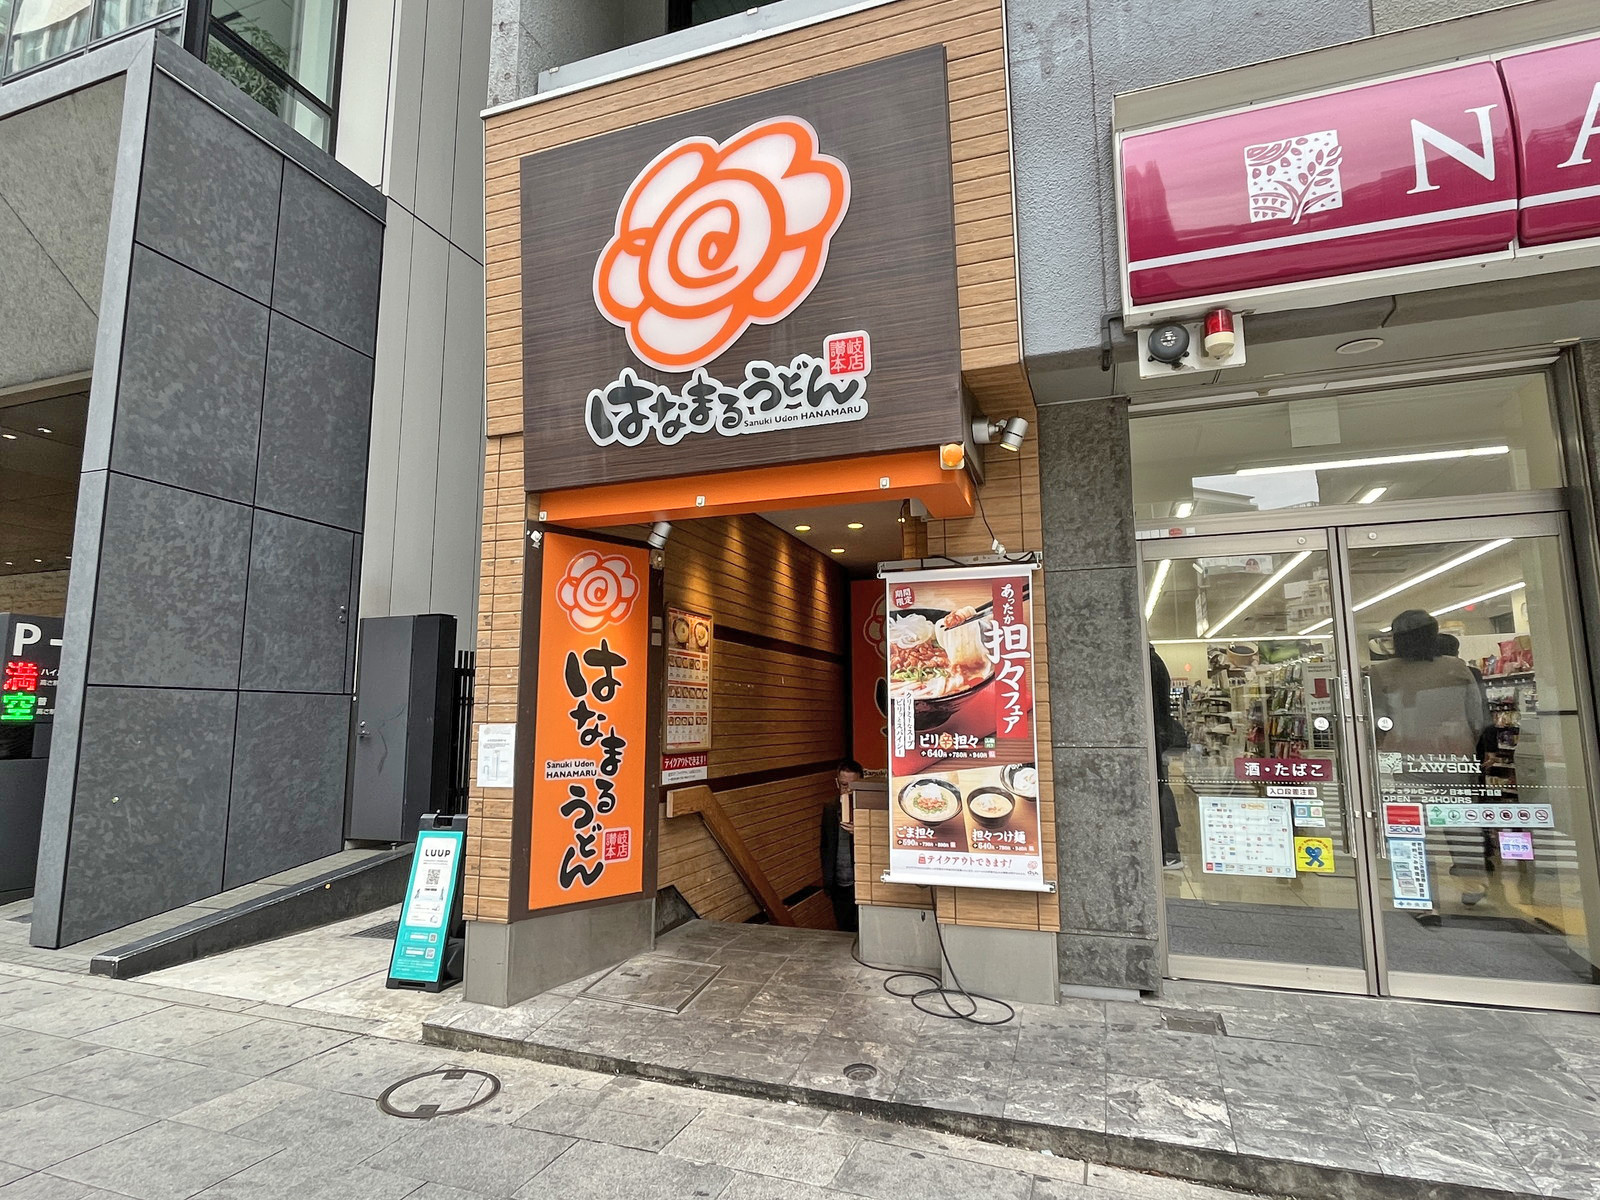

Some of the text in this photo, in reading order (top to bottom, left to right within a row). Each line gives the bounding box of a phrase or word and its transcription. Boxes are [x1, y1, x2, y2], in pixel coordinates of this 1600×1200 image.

[590, 360, 860, 439] はなまるうどん
[744, 405, 862, 428] Sanuki Udon HANAMARU
[12, 622, 42, 656] P
[3, 662, 38, 690] 満
[40, 668, 60, 677] ハイ
[1, 692, 36, 720] 空
[546, 760, 595, 769] Sanuki Udon
[559, 638, 628, 889] はなまるうどん
[1407, 754, 1481, 763] NATURAL
[546, 769, 597, 779] HANAMARU
[1244, 762, 1324, 777] 酒・たばこ
[1408, 762, 1482, 774] LAWSON
[1421, 796, 1472, 804] 24HOURS
[425, 849, 451, 858] LUUP
